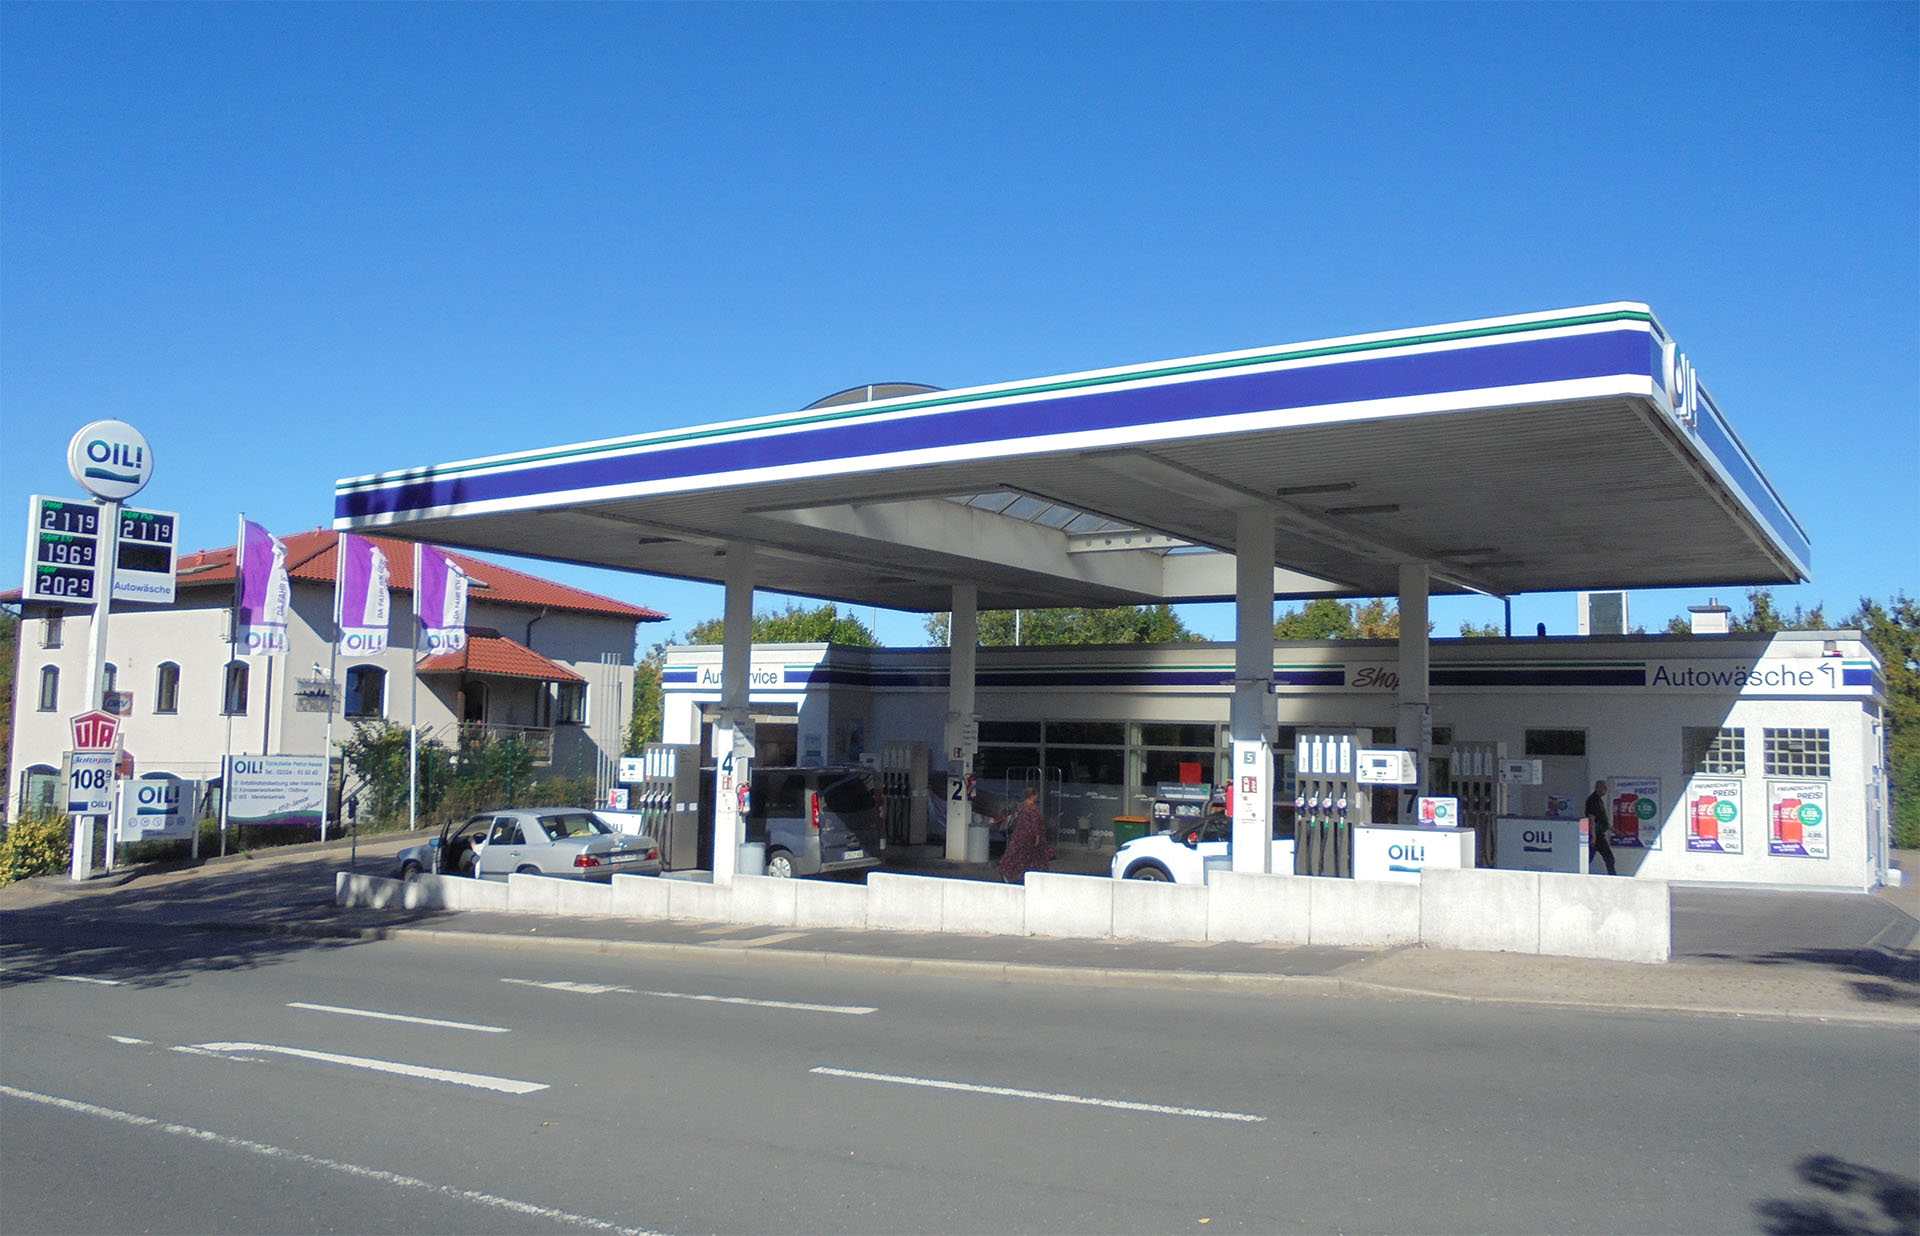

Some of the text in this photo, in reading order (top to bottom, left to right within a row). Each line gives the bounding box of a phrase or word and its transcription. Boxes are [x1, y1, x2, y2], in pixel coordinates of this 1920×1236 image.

[87, 439, 143, 469] OIL!
[114, 581, 172, 594] Autowäsche
[246, 632, 285, 649] OIL!
[346, 634, 382, 650] OIL!
[428, 633, 460, 649] OIL!
[1652, 664, 1815, 687] Autowäsche
[74, 712, 117, 748] UTA
[722, 751, 733, 775] 4
[1246, 752, 1254, 763] 5
[234, 760, 263, 774] OIL!
[138, 786, 180, 804] OIL!
[952, 781, 963, 801] 2
[1403, 789, 1418, 814] 7
[1522, 830, 1553, 844] OIL!
[1388, 844, 1425, 861] OIL!
